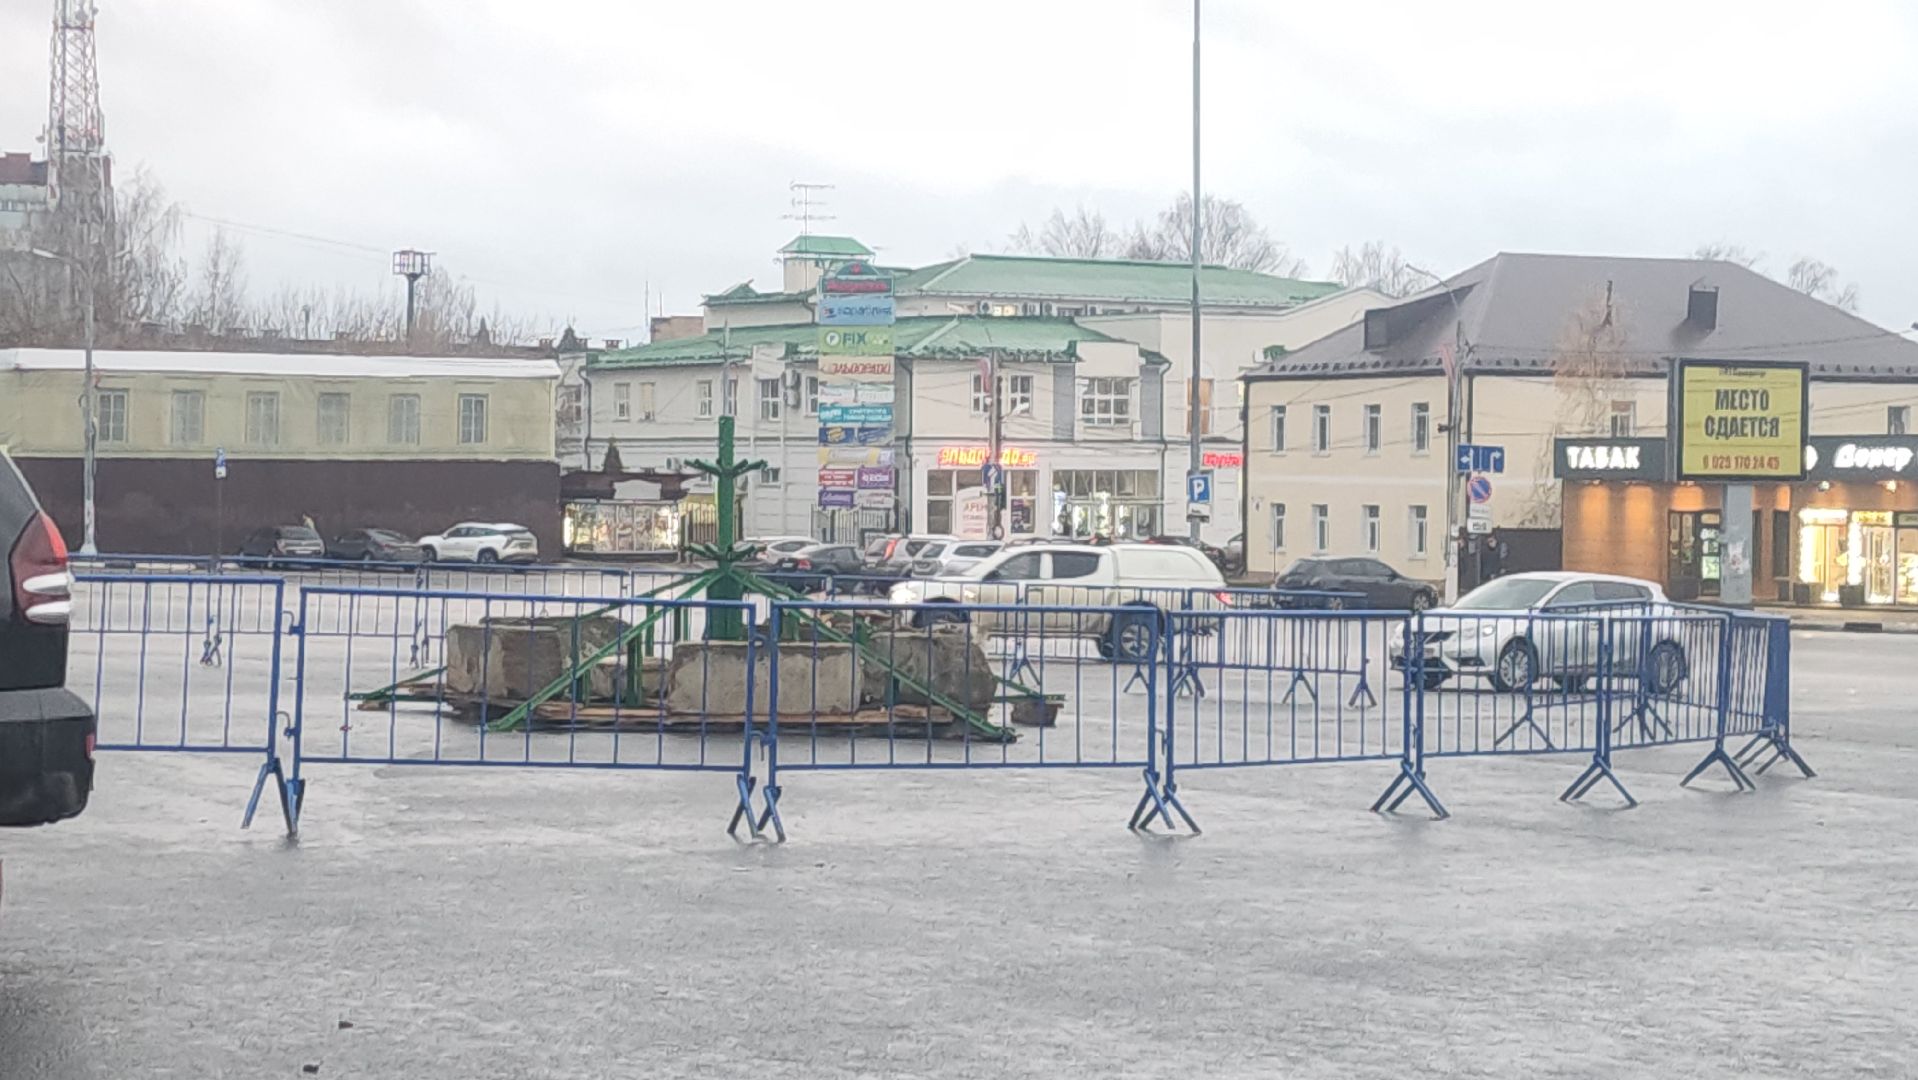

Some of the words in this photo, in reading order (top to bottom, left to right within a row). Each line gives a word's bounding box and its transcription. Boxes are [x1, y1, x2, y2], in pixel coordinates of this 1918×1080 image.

[842, 332, 868, 346] FIX
[1715, 388, 1770, 411] МЕСТО
[1704, 415, 1780, 440] СДАЕТСЯ
[1566, 446, 1641, 470] ТАБАК
[1834, 444, 1914, 472] Донер
[1192, 479, 1205, 501] P
